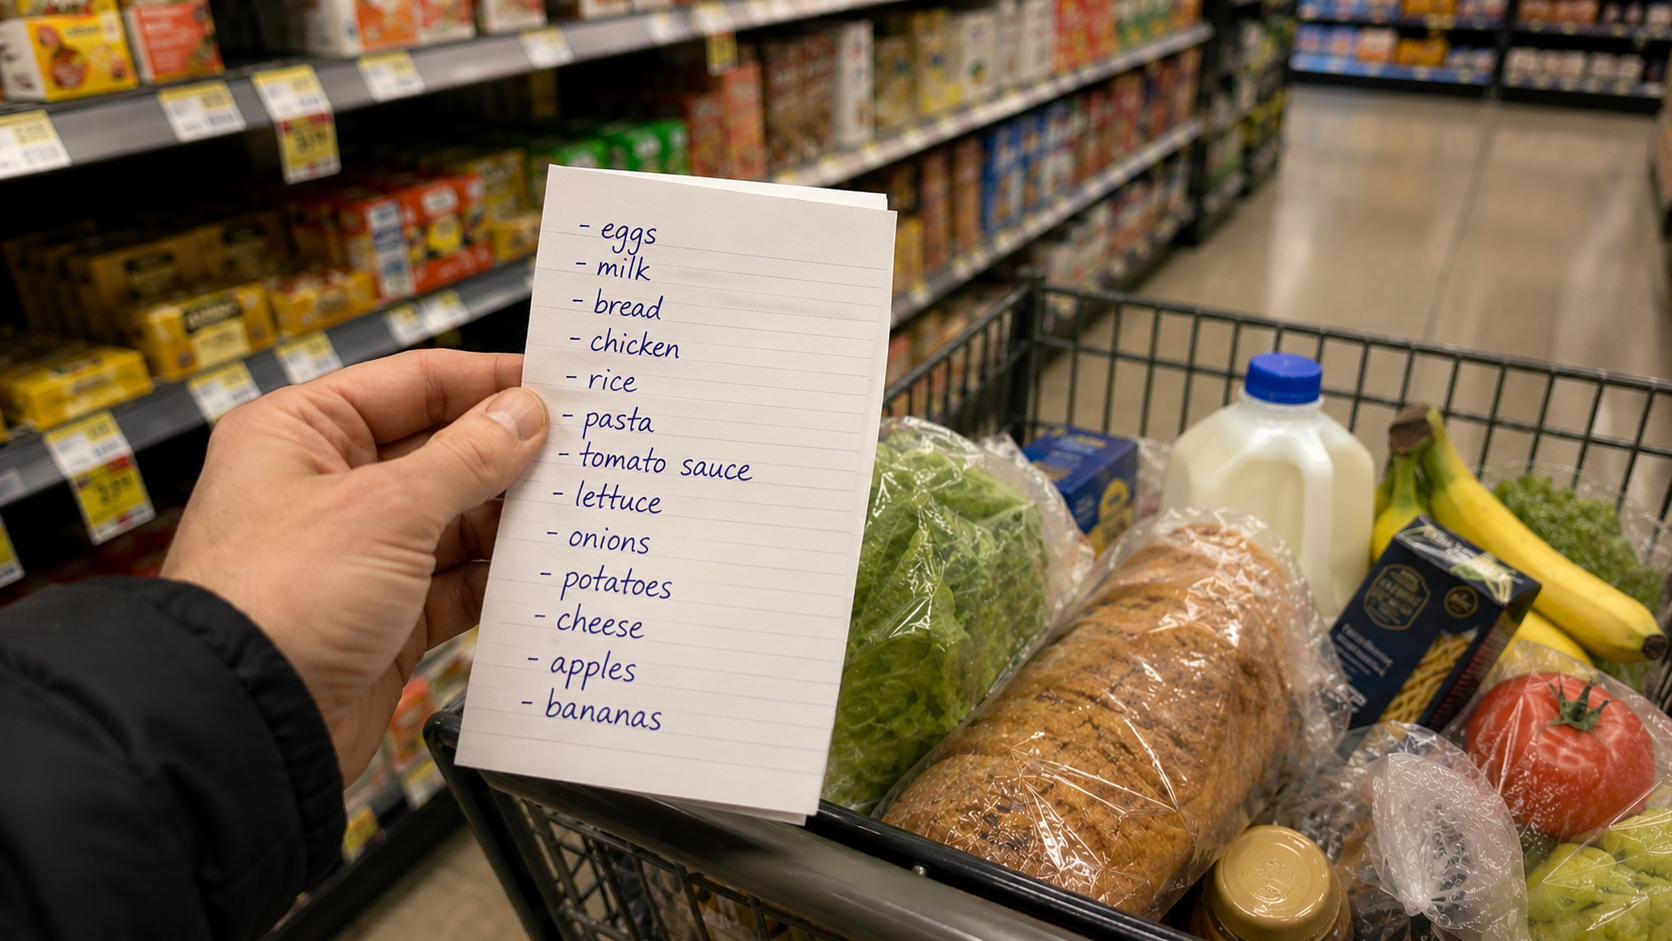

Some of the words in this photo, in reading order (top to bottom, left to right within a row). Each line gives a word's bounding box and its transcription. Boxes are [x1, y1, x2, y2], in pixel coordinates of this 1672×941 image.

[601, 223, 657, 256] eggs
[596, 256, 651, 282] milk
[593, 288, 664, 320] bread
[590, 327, 680, 359] chicken
[588, 368, 638, 394] rice
[582, 406, 655, 440] pasta
[579, 441, 667, 474] tomato
[680, 458, 752, 482] sauce
[575, 480, 662, 515] lettuce
[568, 527, 650, 555] onions
[559, 565, 672, 601] potatoes
[556, 603, 643, 640] cheese
[550, 650, 636, 691] apples
[545, 688, 662, 731] bananas
